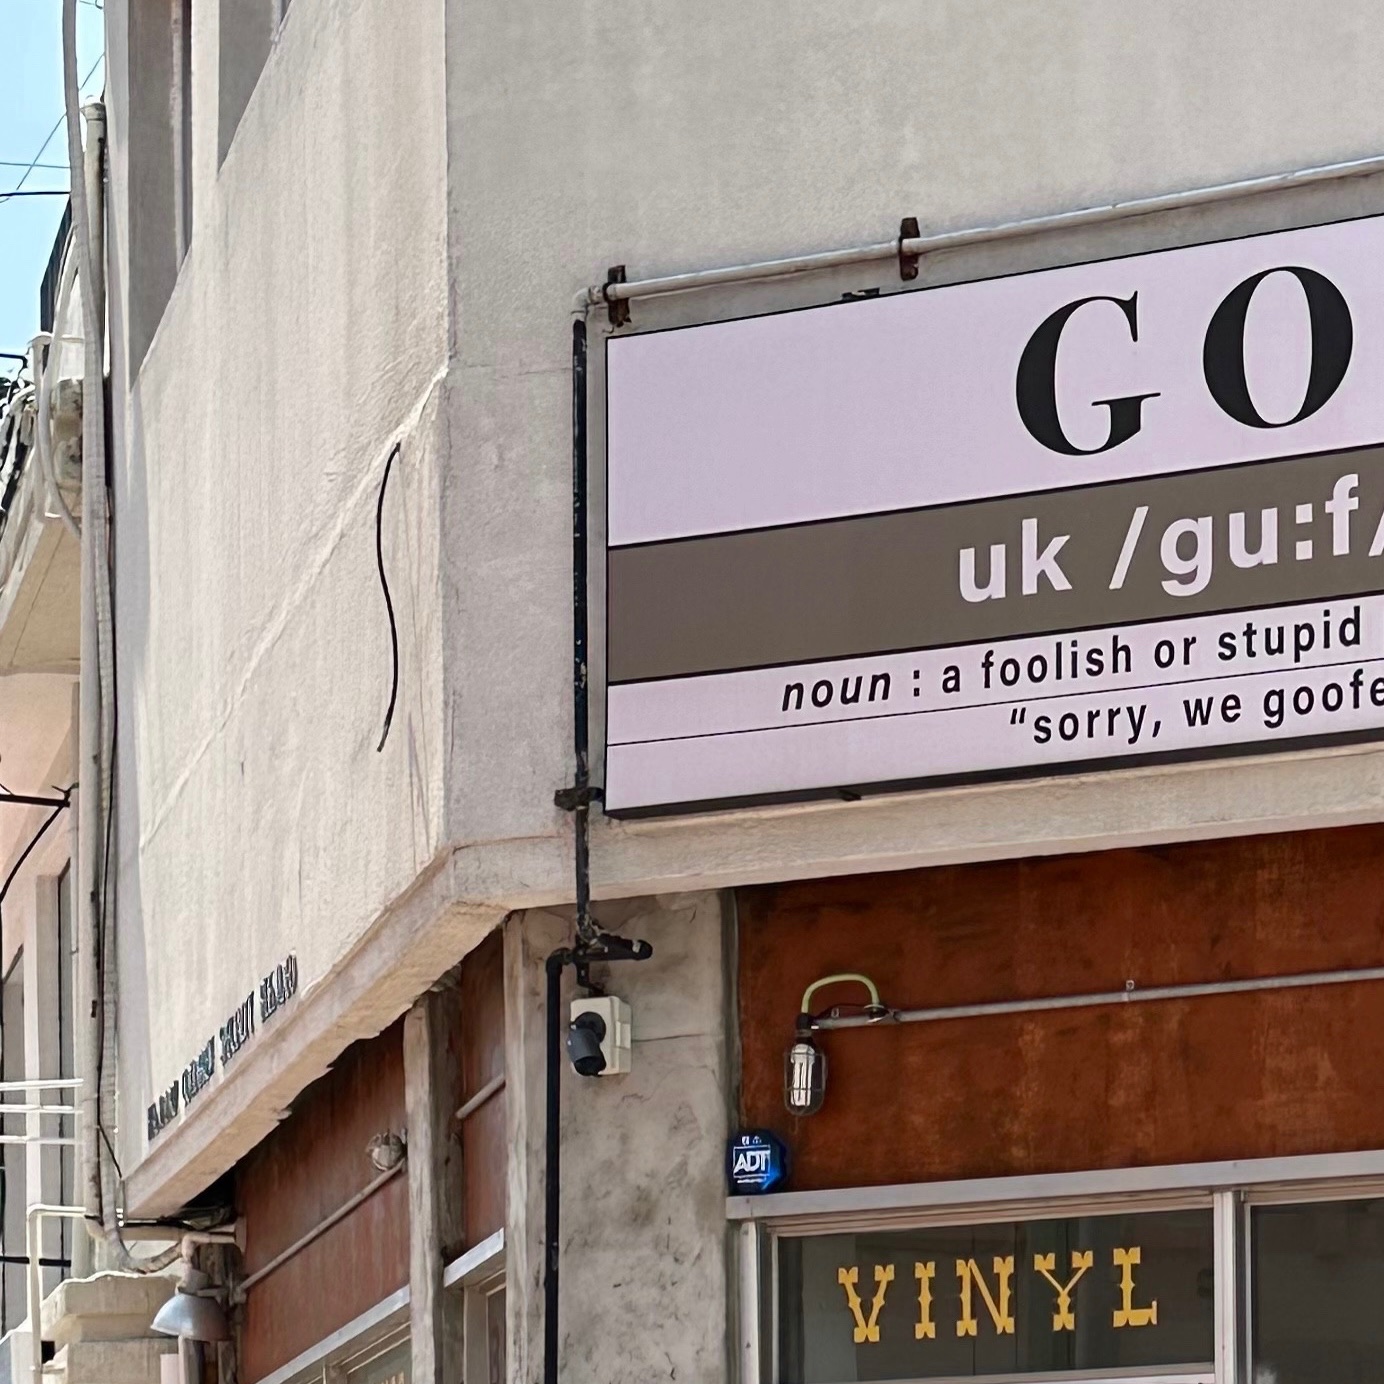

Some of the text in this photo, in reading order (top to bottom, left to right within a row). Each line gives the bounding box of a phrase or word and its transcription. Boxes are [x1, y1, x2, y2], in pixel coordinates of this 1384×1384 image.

[960, 518, 1072, 602] uk
[782, 673, 890, 711] noun
[942, 666, 960, 693] a
[982, 635, 1131, 688] foolish
[1155, 637, 1196, 668] or
[1218, 606, 1360, 663] stupid
[1183, 695, 1241, 726] we
[733, 1150, 770, 1173] ADT
[838, 1246, 1158, 1343] VINYL
